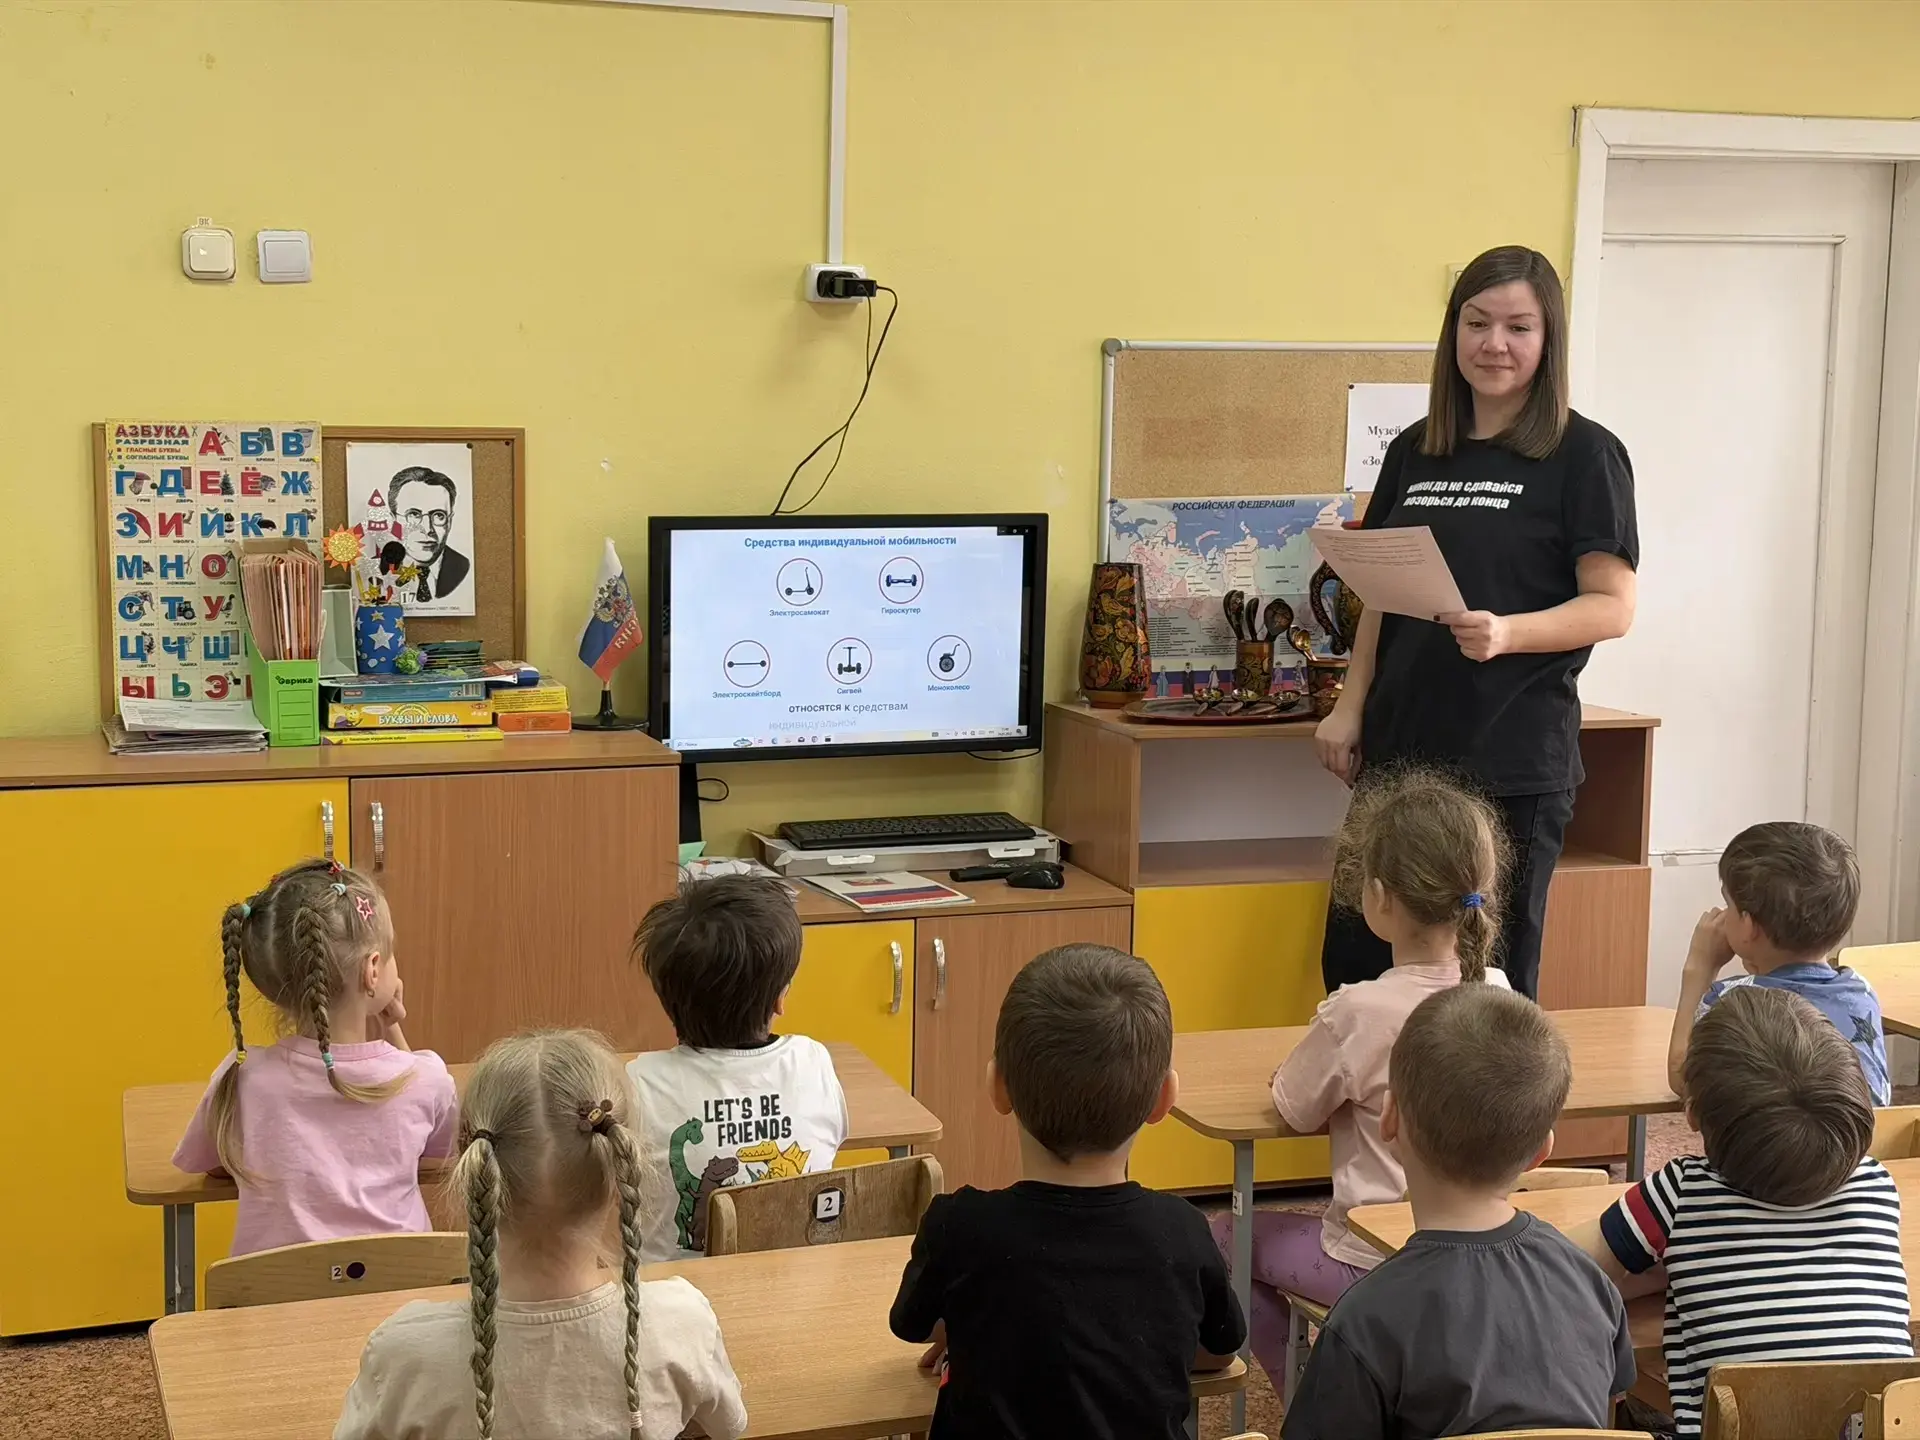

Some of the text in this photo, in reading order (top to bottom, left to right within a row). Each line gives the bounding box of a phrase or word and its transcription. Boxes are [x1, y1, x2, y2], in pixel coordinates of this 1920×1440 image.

[115, 424, 190, 438] АЗБУКА
[199, 431, 225, 456] А
[241, 431, 264, 456] Б
[1367, 425, 1401, 439] Музей
[282, 432, 305, 457] В
[115, 471, 136, 496] Г
[157, 469, 186, 497] Д
[200, 471, 221, 496] Е
[241, 467, 263, 496] Ё
[281, 471, 310, 496] Ж
[1447, 480, 1463, 493] не
[1463, 480, 1524, 495] сдавайся
[1171, 499, 1296, 511] РОССИЙСКАЯ ФЕДЕРАЦИЯ
[1454, 496, 1470, 508] до
[1470, 496, 1511, 510] конца
[116, 512, 139, 538] З
[158, 512, 184, 538] И
[200, 507, 224, 537] Й
[241, 512, 264, 537] К
[282, 513, 308, 537] Л
[744, 535, 957, 549] Средства индивидуальной мобильности
[116, 555, 143, 580] М
[159, 554, 184, 579] Н
[201, 554, 227, 579] О
[118, 595, 143, 621] С
[160, 596, 185, 621] Т
[203, 596, 226, 621] У
[402, 592, 416, 603] 17
[769, 608, 830, 617] Электросамокат
[881, 606, 921, 616] Гироскутер
[119, 636, 148, 663] Ц
[162, 636, 186, 660] Ч
[203, 636, 231, 661] Ш
[122, 676, 155, 699] Ы
[204, 675, 229, 700] Э
[275, 675, 314, 686] Эврика
[836, 686, 863, 695] Сигвей
[927, 682, 971, 692] Моноколесо
[711, 689, 782, 699] Электроскейтборд
[378, 712, 460, 725] БУКВЫ И СЛОВА
[788, 702, 909, 714] относятся к средствам
[768, 717, 857, 732] индивидуальной
[704, 1094, 781, 1123] LET'S BE
[718, 1116, 792, 1147] FRIENDS
[824, 1197, 832, 1212] 2
[334, 1266, 342, 1277] 2
